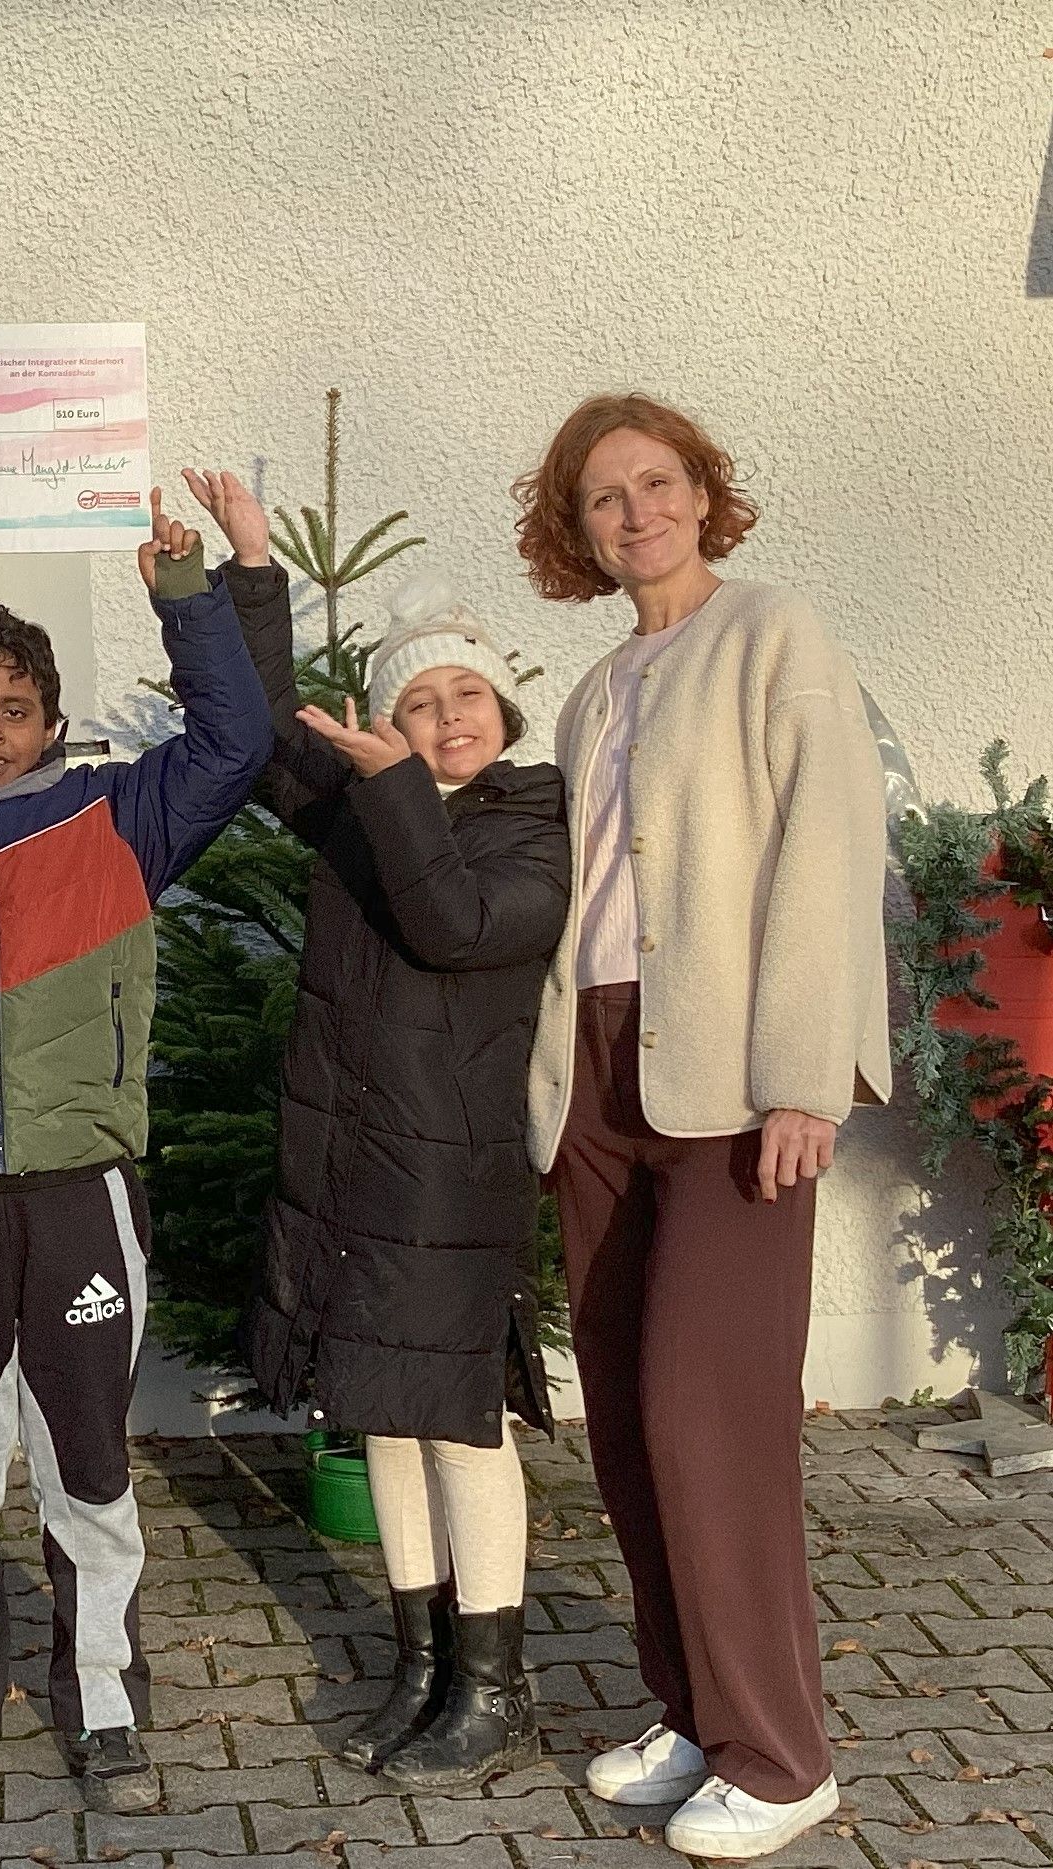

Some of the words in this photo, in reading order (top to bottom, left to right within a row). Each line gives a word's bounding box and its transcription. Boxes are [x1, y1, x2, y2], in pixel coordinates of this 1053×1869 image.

[27, 358, 78, 368] Integrativer
[21, 370, 36, 378] der
[56, 409, 75, 419] 510
[76, 409, 101, 418] Euro
